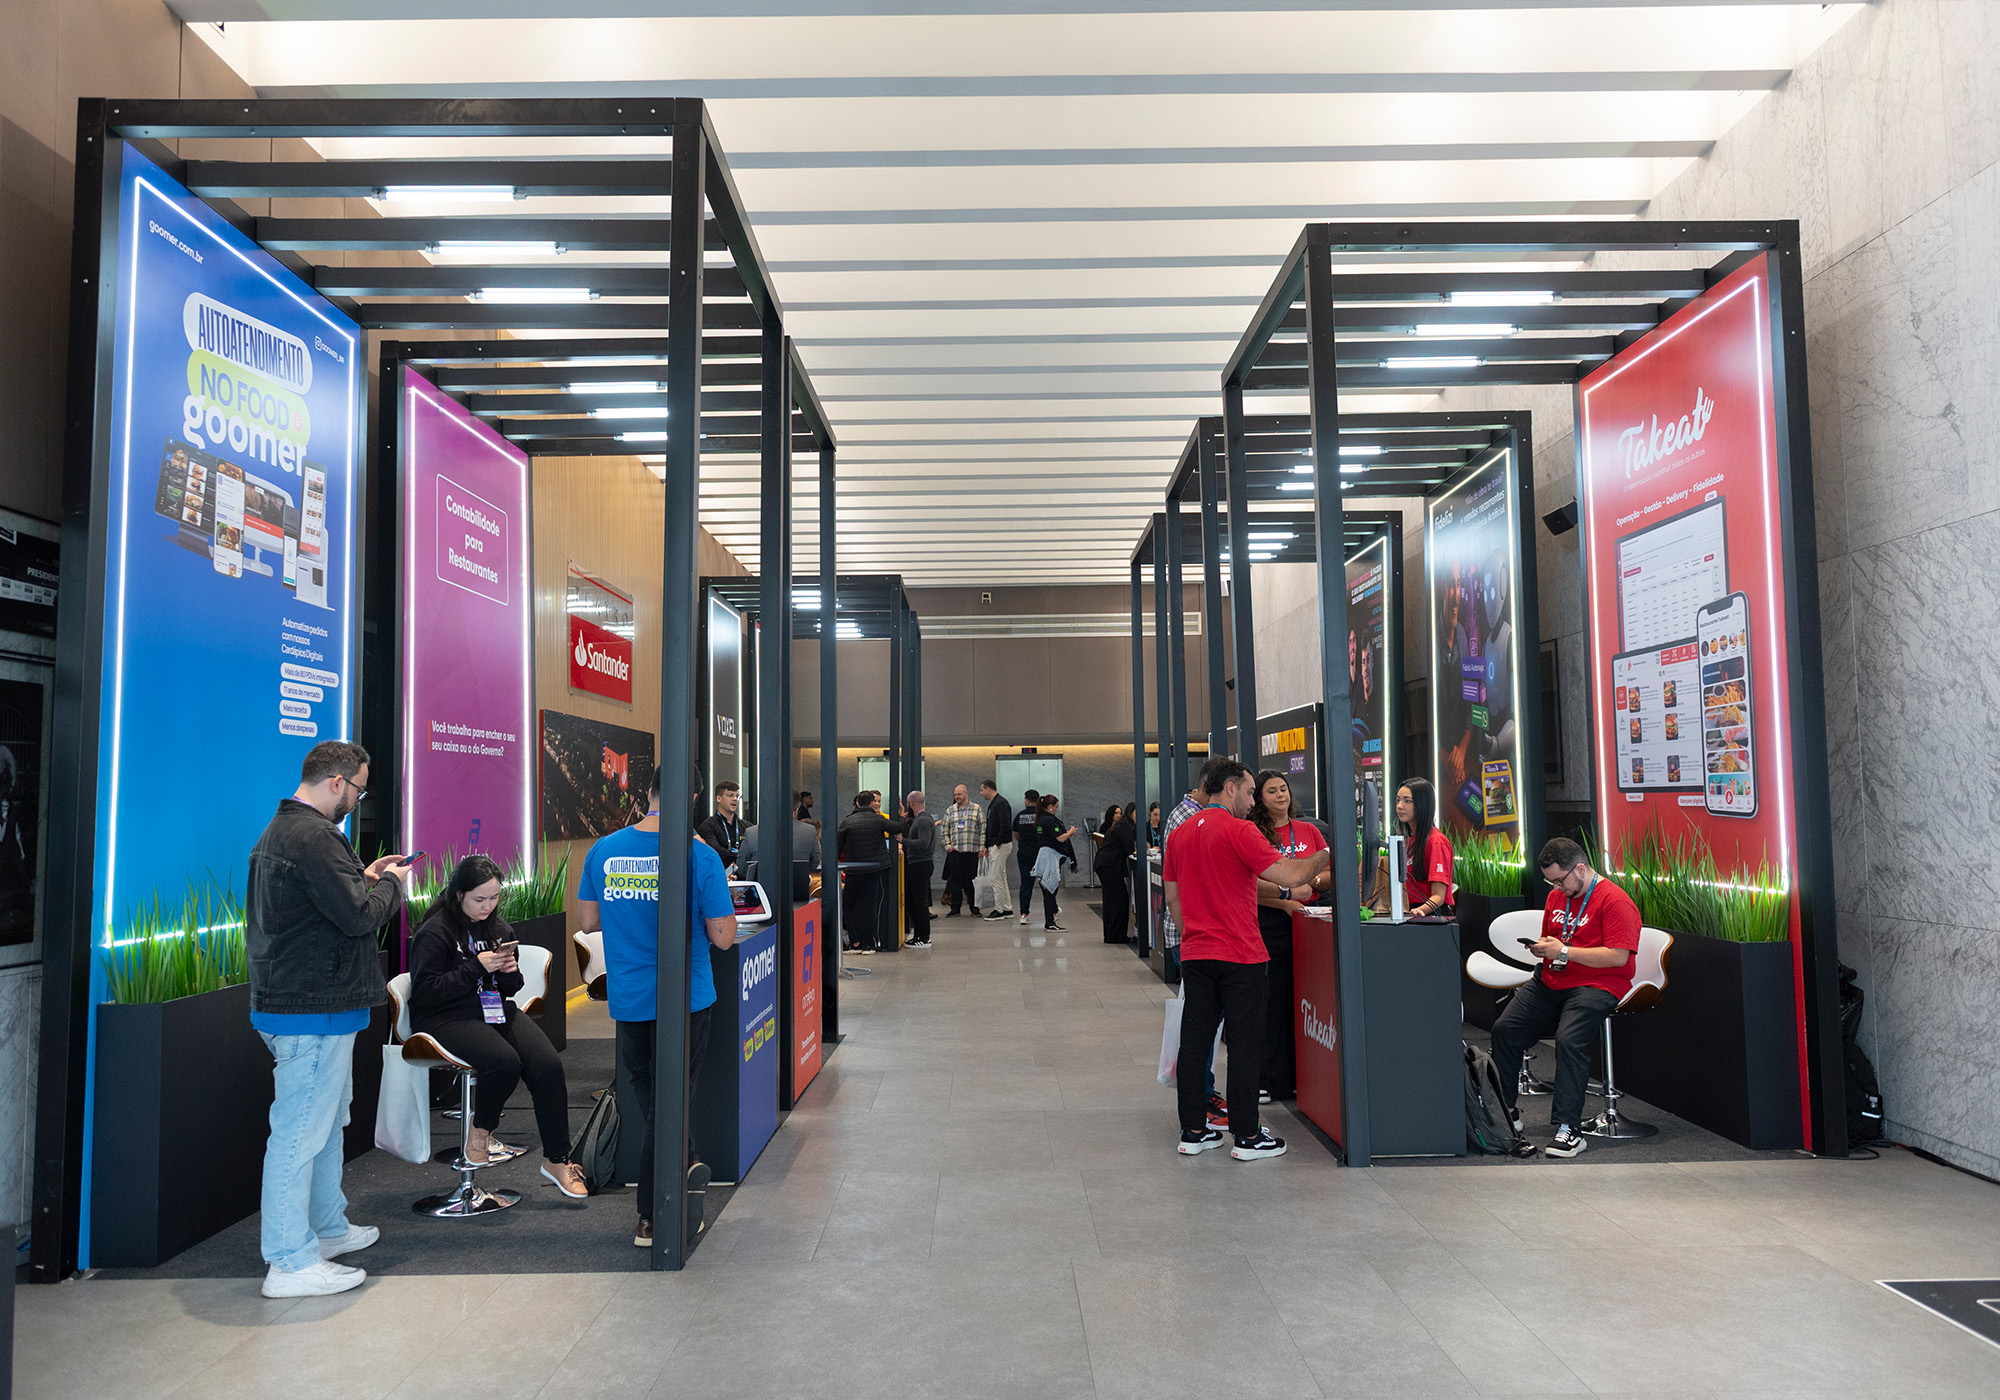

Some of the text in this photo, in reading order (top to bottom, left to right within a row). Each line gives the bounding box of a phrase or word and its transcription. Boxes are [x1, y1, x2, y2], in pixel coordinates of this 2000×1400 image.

[150, 220, 204, 264] goomer.com.br
[199, 303, 304, 387] AUTOATENDIMENTO
[201, 363, 289, 430] NO FOOD
[183, 395, 307, 477] goomer
[1618, 386, 1714, 479] Takeat
[446, 495, 500, 537] Contabilidade
[1616, 510, 1640, 527] Operação
[1644, 501, 1662, 514] Gestão
[1666, 489, 1689, 505] Delivery
[1693, 473, 1724, 493] Fidelidade
[465, 534, 483, 553] para
[448, 547, 499, 584] Restaurantes
[588, 643, 629, 681] Santander
[432, 720, 516, 742] Você trabalha para encher o seu
[717, 715, 736, 738] VOXEL
[432, 740, 504, 756] seu caixa ou o do Governo?
[1291, 757, 1304, 771] STORE
[611, 877, 659, 889] NO FOOD
[742, 945, 775, 1001] goomer
[1301, 999, 1337, 1051] Takeat
